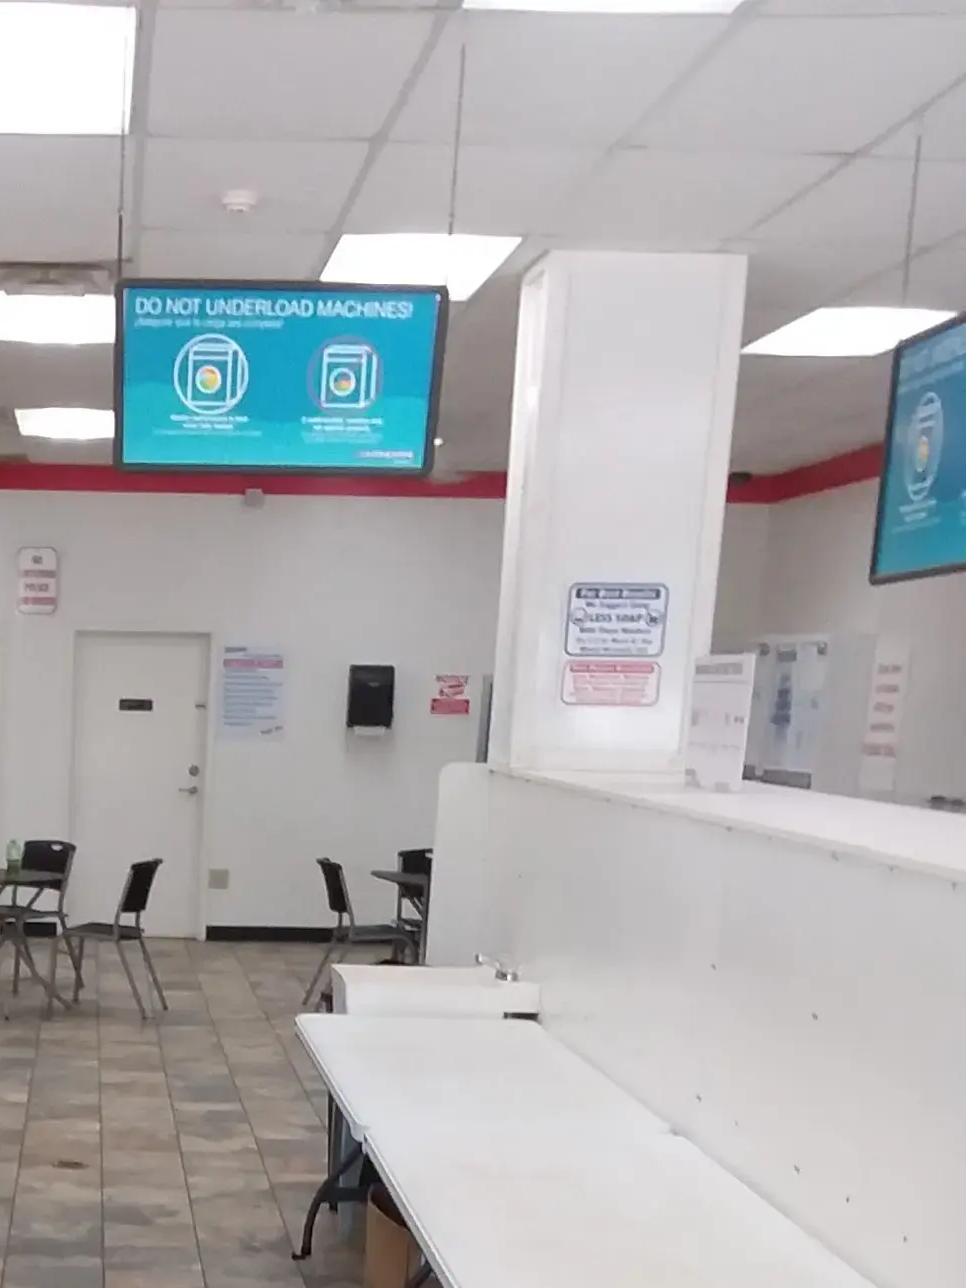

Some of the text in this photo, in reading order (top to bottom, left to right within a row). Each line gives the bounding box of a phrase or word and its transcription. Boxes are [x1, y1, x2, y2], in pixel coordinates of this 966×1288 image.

[134, 296, 414, 320] DO NOT UNDERLOAD MACHINES!
